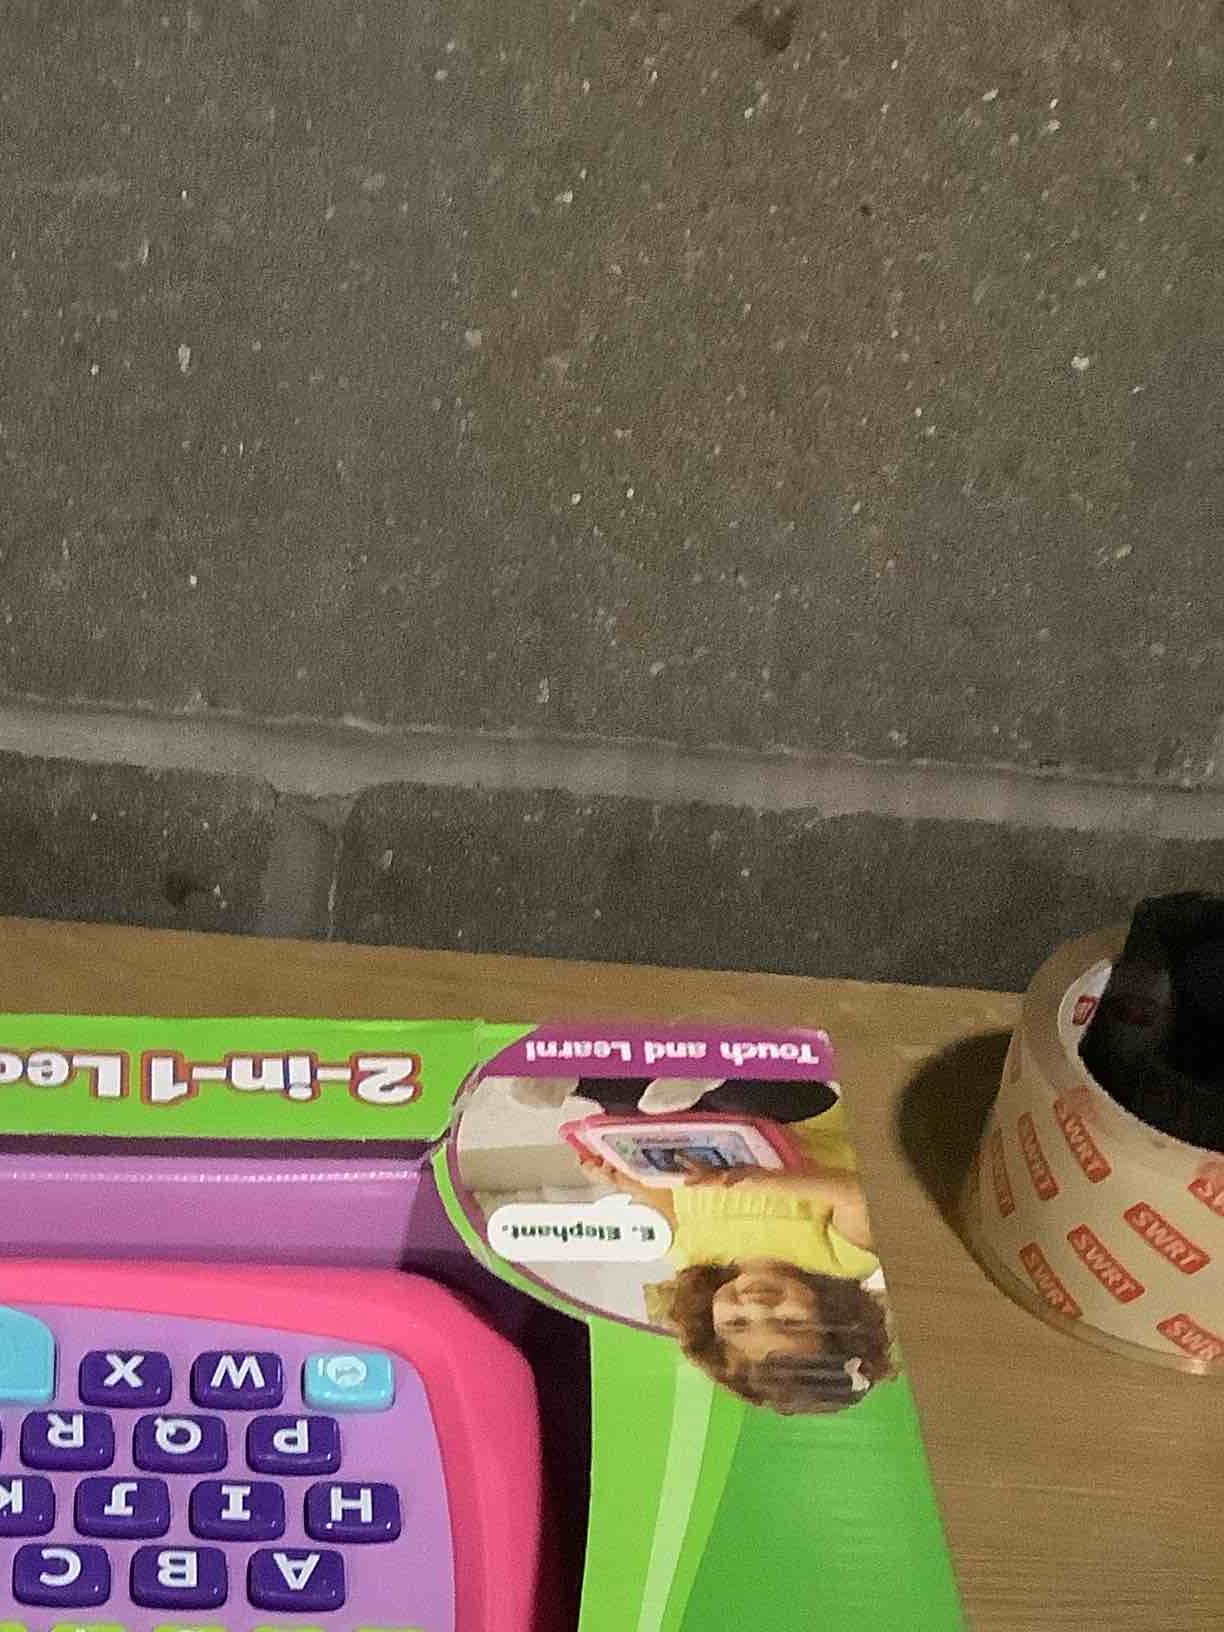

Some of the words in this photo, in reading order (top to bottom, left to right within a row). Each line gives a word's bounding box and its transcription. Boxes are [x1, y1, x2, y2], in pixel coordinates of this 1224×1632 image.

[525, 1040, 632, 1063] Learn!
[644, 1041, 707, 1064] and
[720, 1041, 819, 1065] Touch
[151, 1054, 415, 1103] 2-in-1
[502, 1221, 622, 1242] Elephant.
[104, 1355, 144, 1387] X
[211, 1356, 264, 1388] W
[48, 1414, 83, 1447] R
[155, 1418, 201, 1453] Q
[274, 1420, 308, 1453] P
[104, 1483, 137, 1515] J
[222, 1486, 250, 1520] I
[331, 1487, 372, 1521] H
[40, 1549, 80, 1585] C
[158, 1551, 197, 1587] B
[274, 1553, 319, 1589] A
